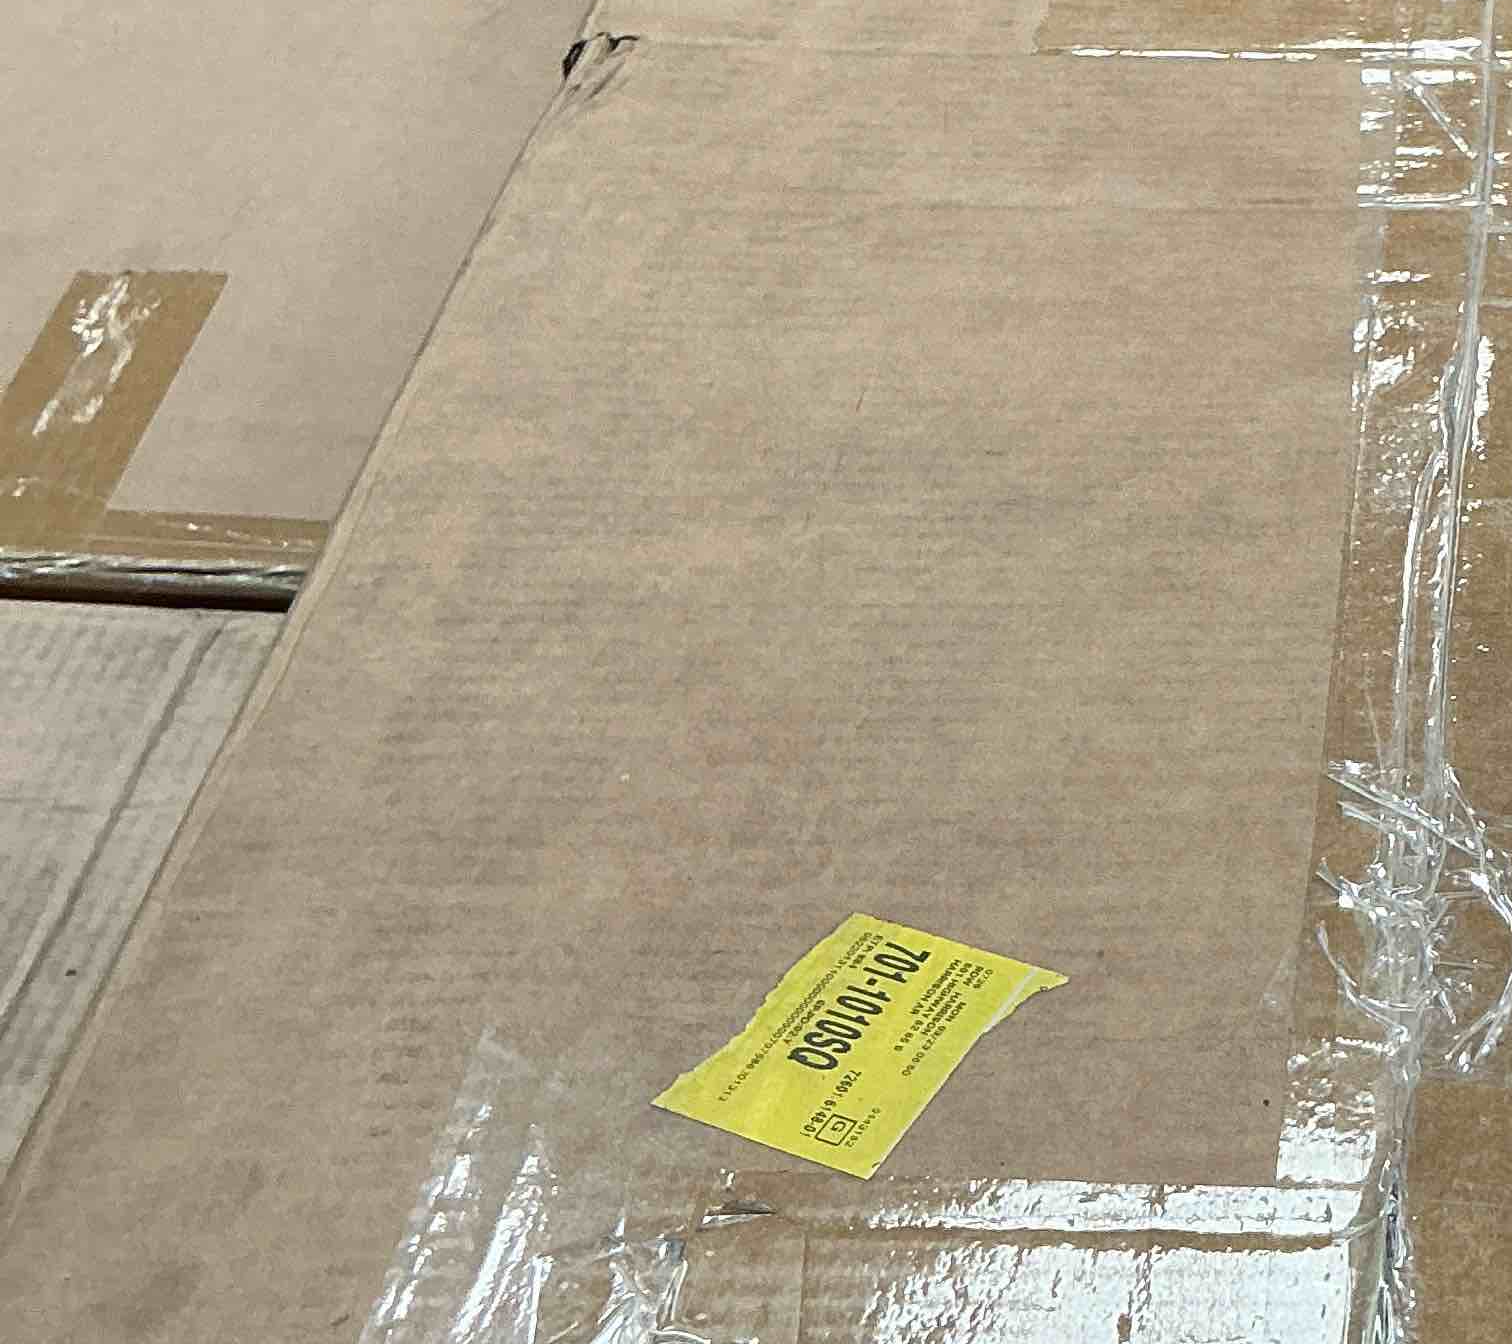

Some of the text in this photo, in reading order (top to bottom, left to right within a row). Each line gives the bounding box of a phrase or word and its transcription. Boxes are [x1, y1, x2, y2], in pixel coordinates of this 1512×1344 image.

[921, 977, 958, 1019] HIGHWAY
[922, 958, 960, 1002] HARRISON
[786, 941, 932, 1072] 701-1010SQ
[921, 991, 960, 1036] HARRISON
[829, 1119, 848, 1133] G
